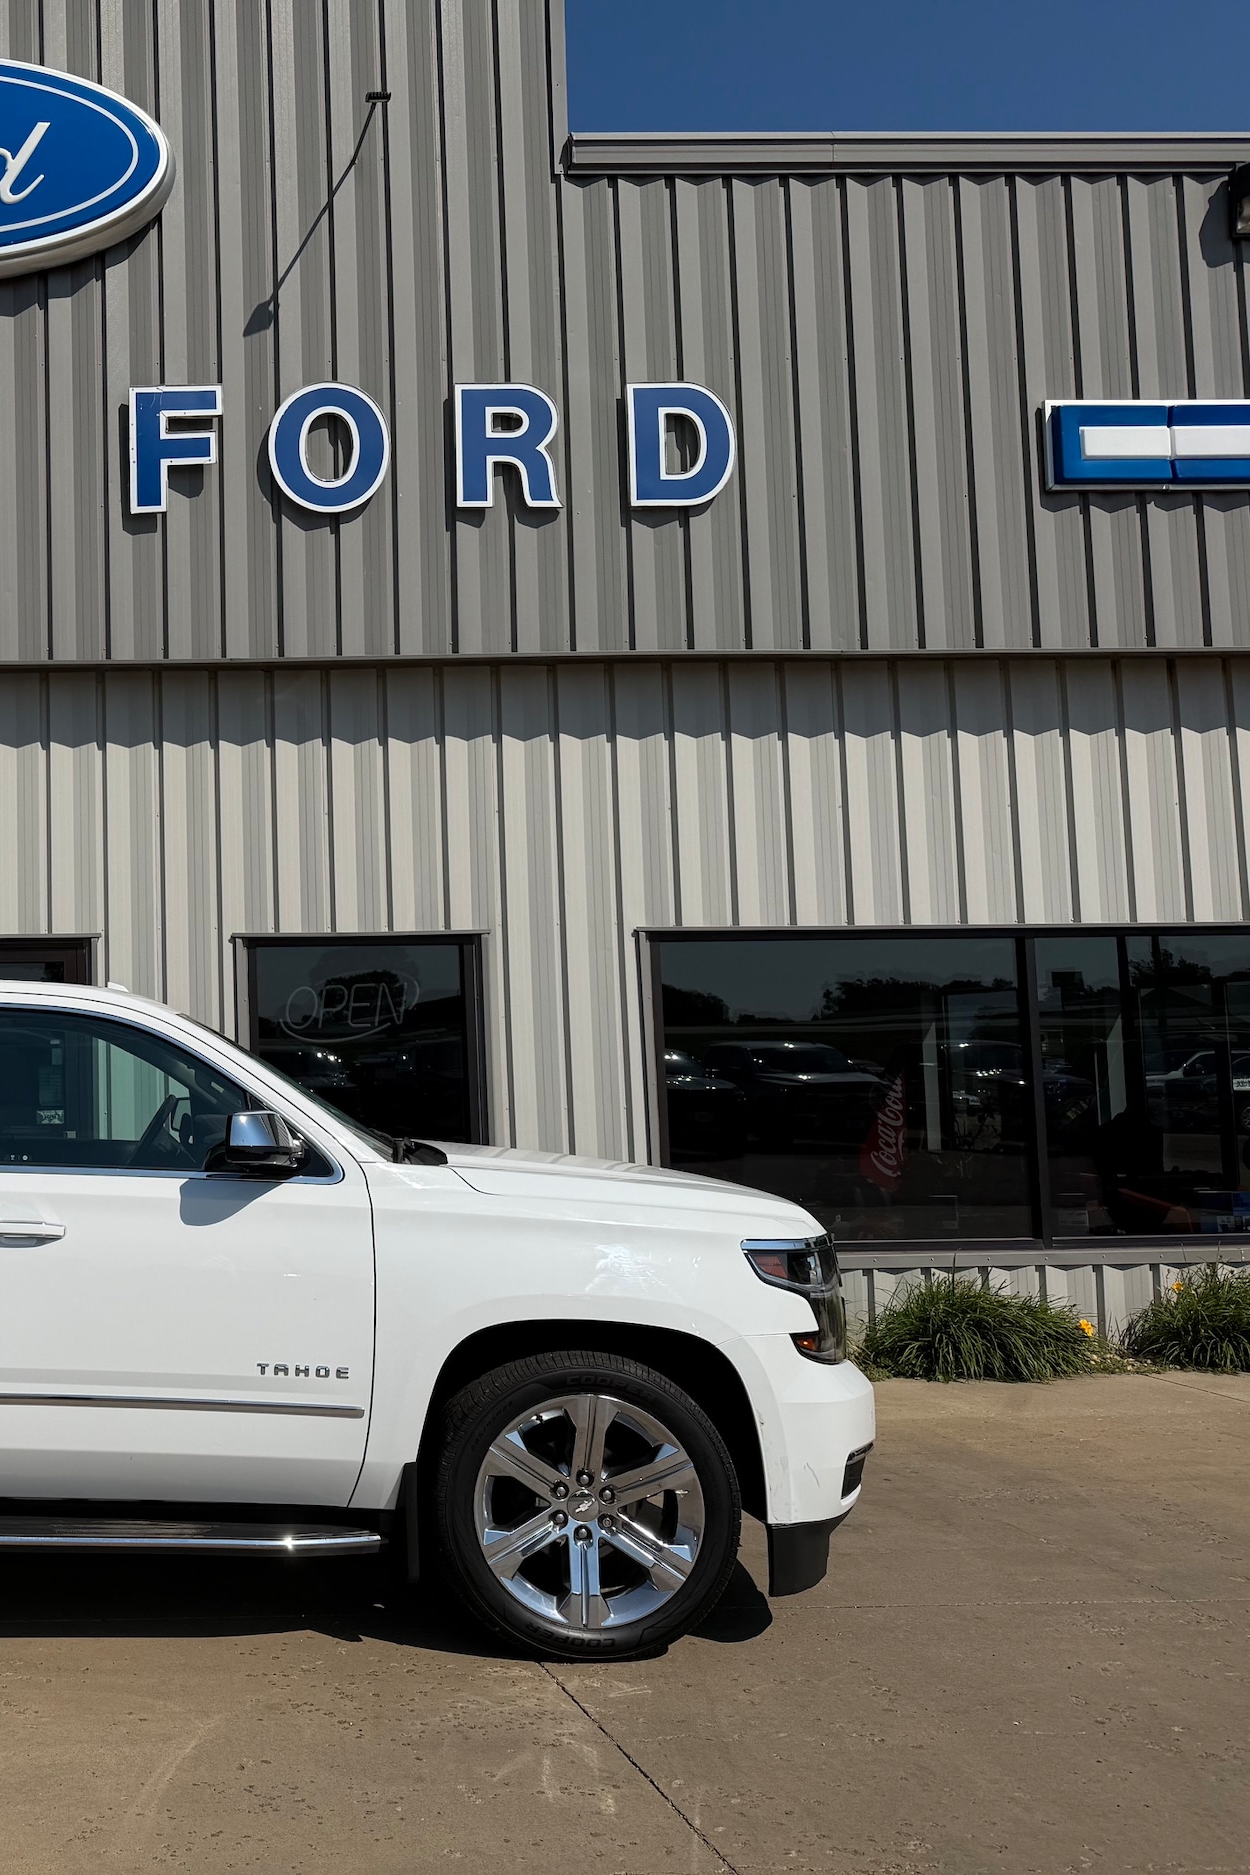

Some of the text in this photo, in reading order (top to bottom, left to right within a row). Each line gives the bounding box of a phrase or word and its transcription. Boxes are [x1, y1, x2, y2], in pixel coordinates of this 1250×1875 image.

[129, 381, 737, 514] FORD
[285, 982, 407, 1029] OPEN
[256, 1363, 350, 1379] TAHOE
[565, 1374, 656, 1402] COOPER
[525, 1622, 616, 1649] COOPER
